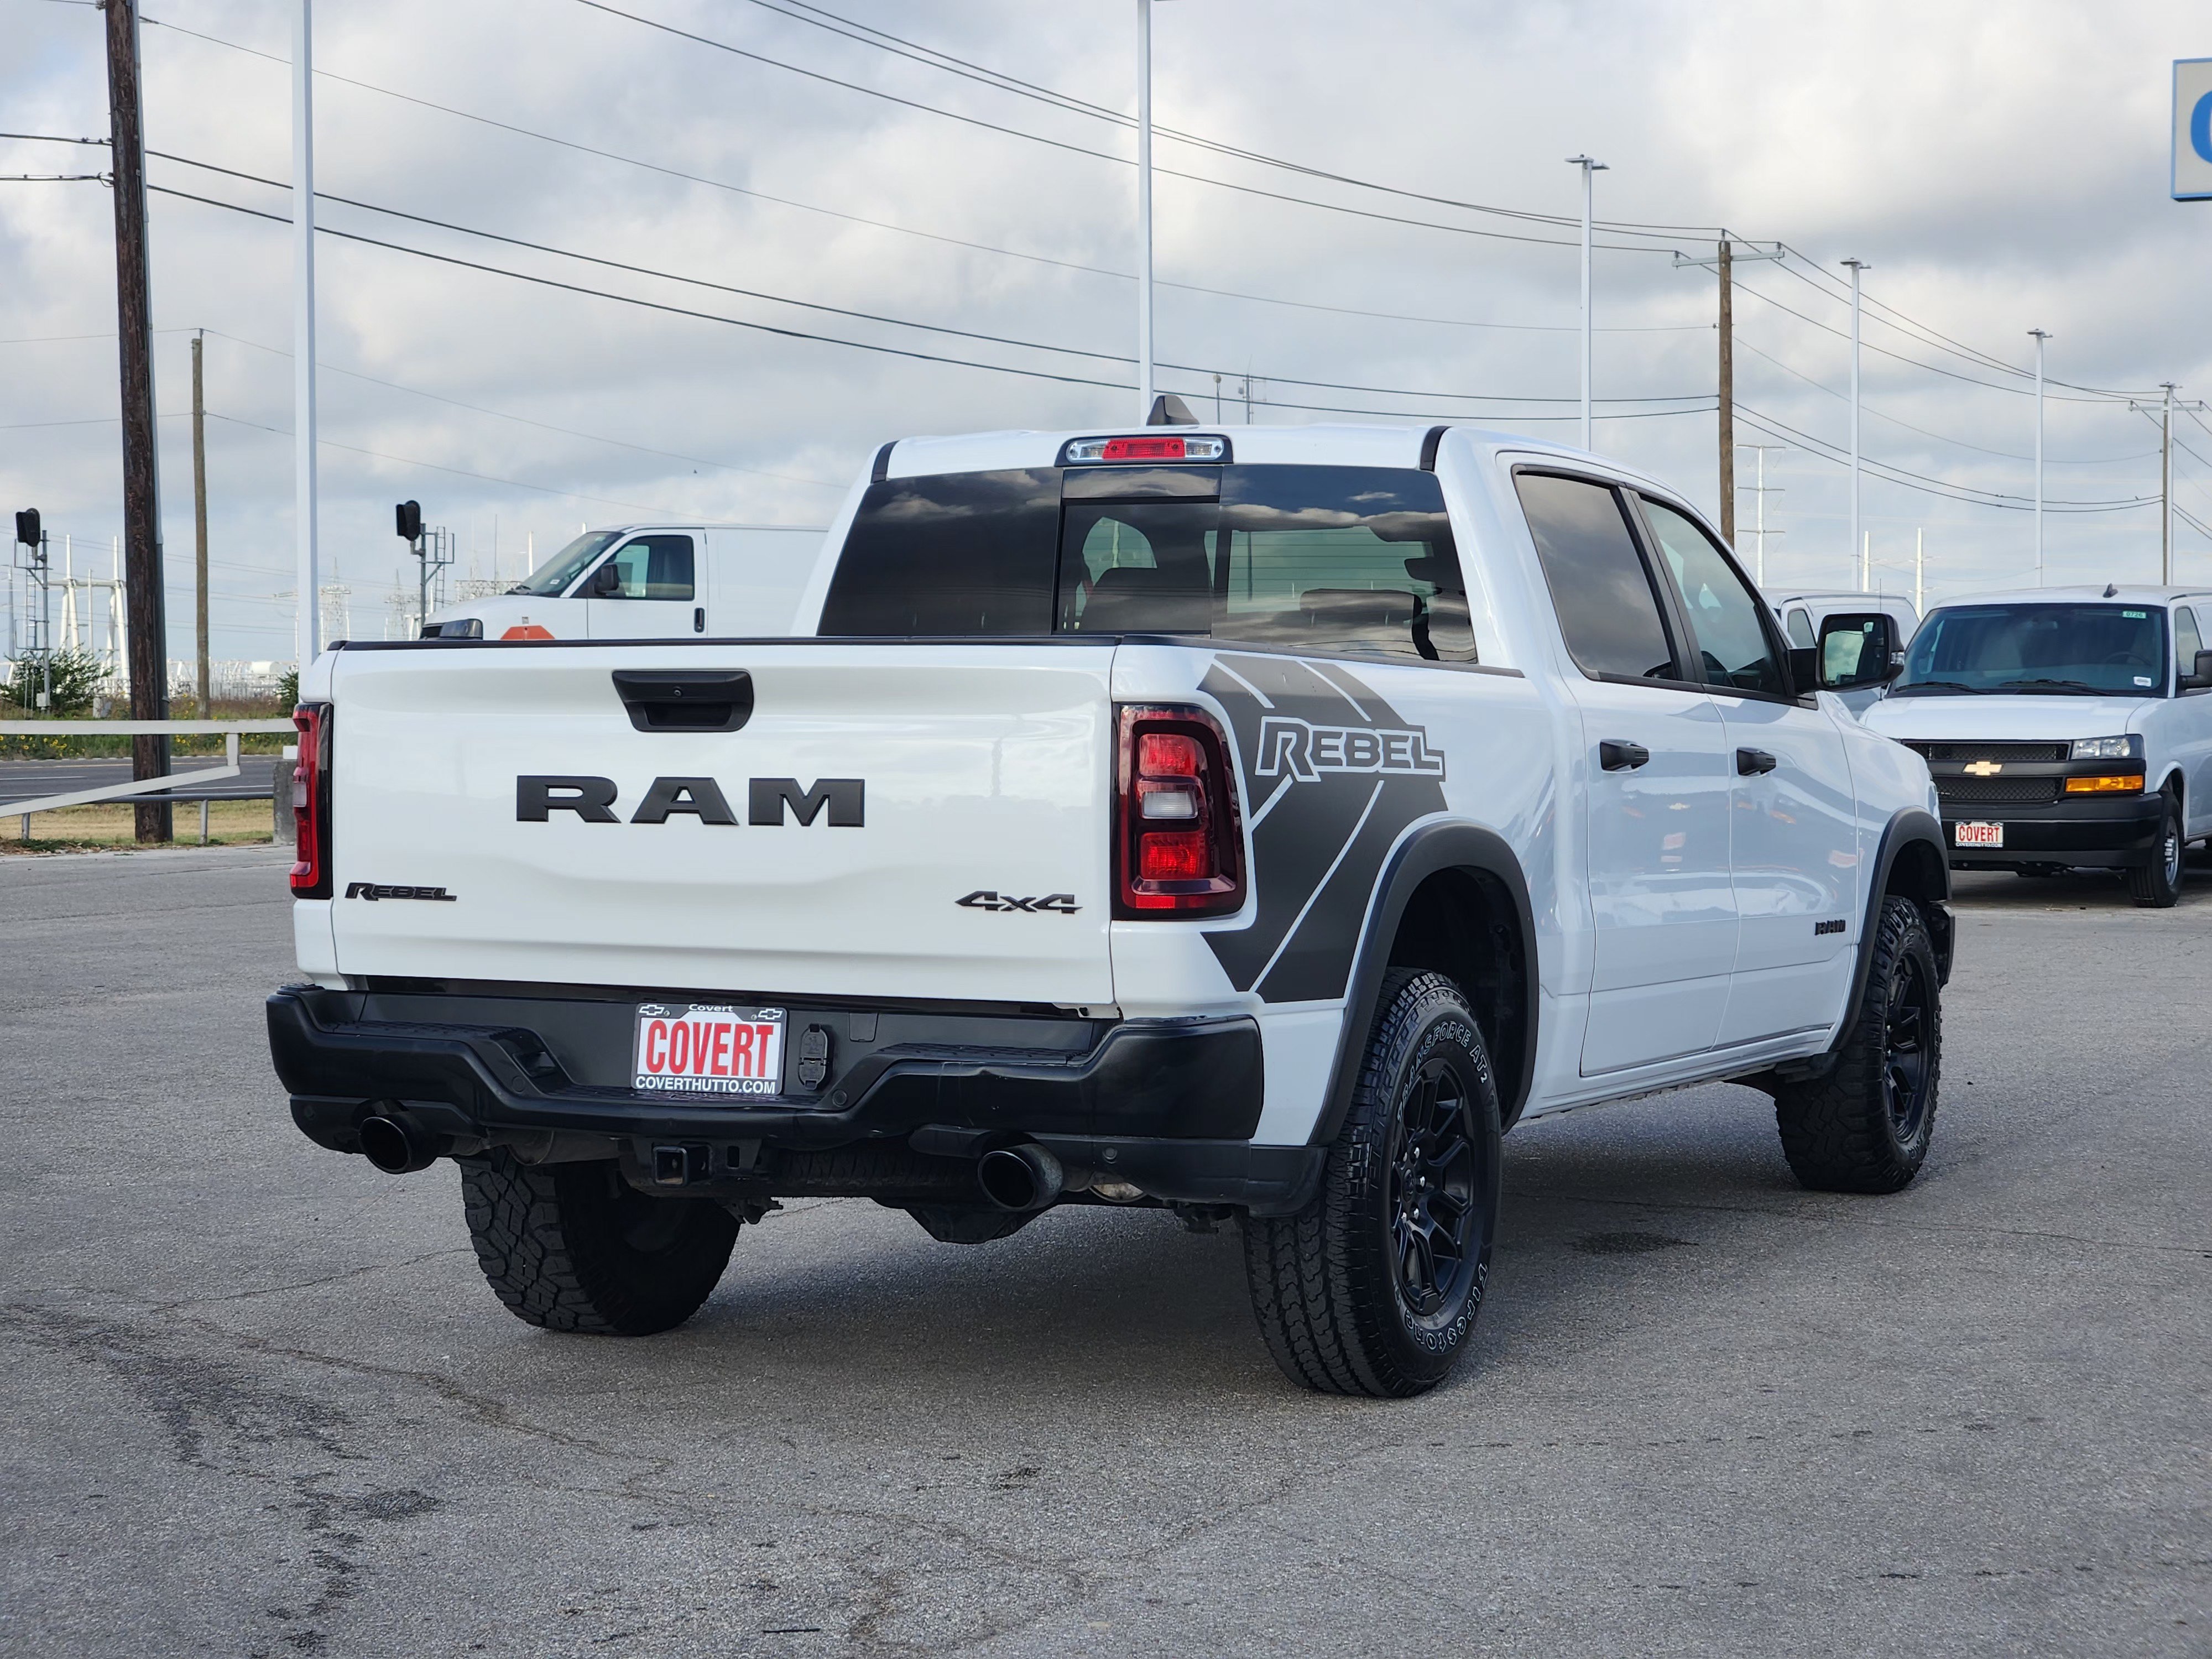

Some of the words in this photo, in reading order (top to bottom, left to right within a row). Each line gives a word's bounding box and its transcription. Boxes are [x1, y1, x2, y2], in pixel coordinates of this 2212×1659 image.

[1254, 716, 1443, 782] REBEL
[517, 775, 865, 828] RAM
[1958, 825, 2000, 842] COVERT
[345, 882, 458, 901] REBEL
[688, 1003, 734, 1013] Covert
[646, 1019, 774, 1078] COVERT
[635, 1075, 776, 1094] COVERTHUTTO.COM
[1397, 1021, 1472, 1123] TRANSFORCE
